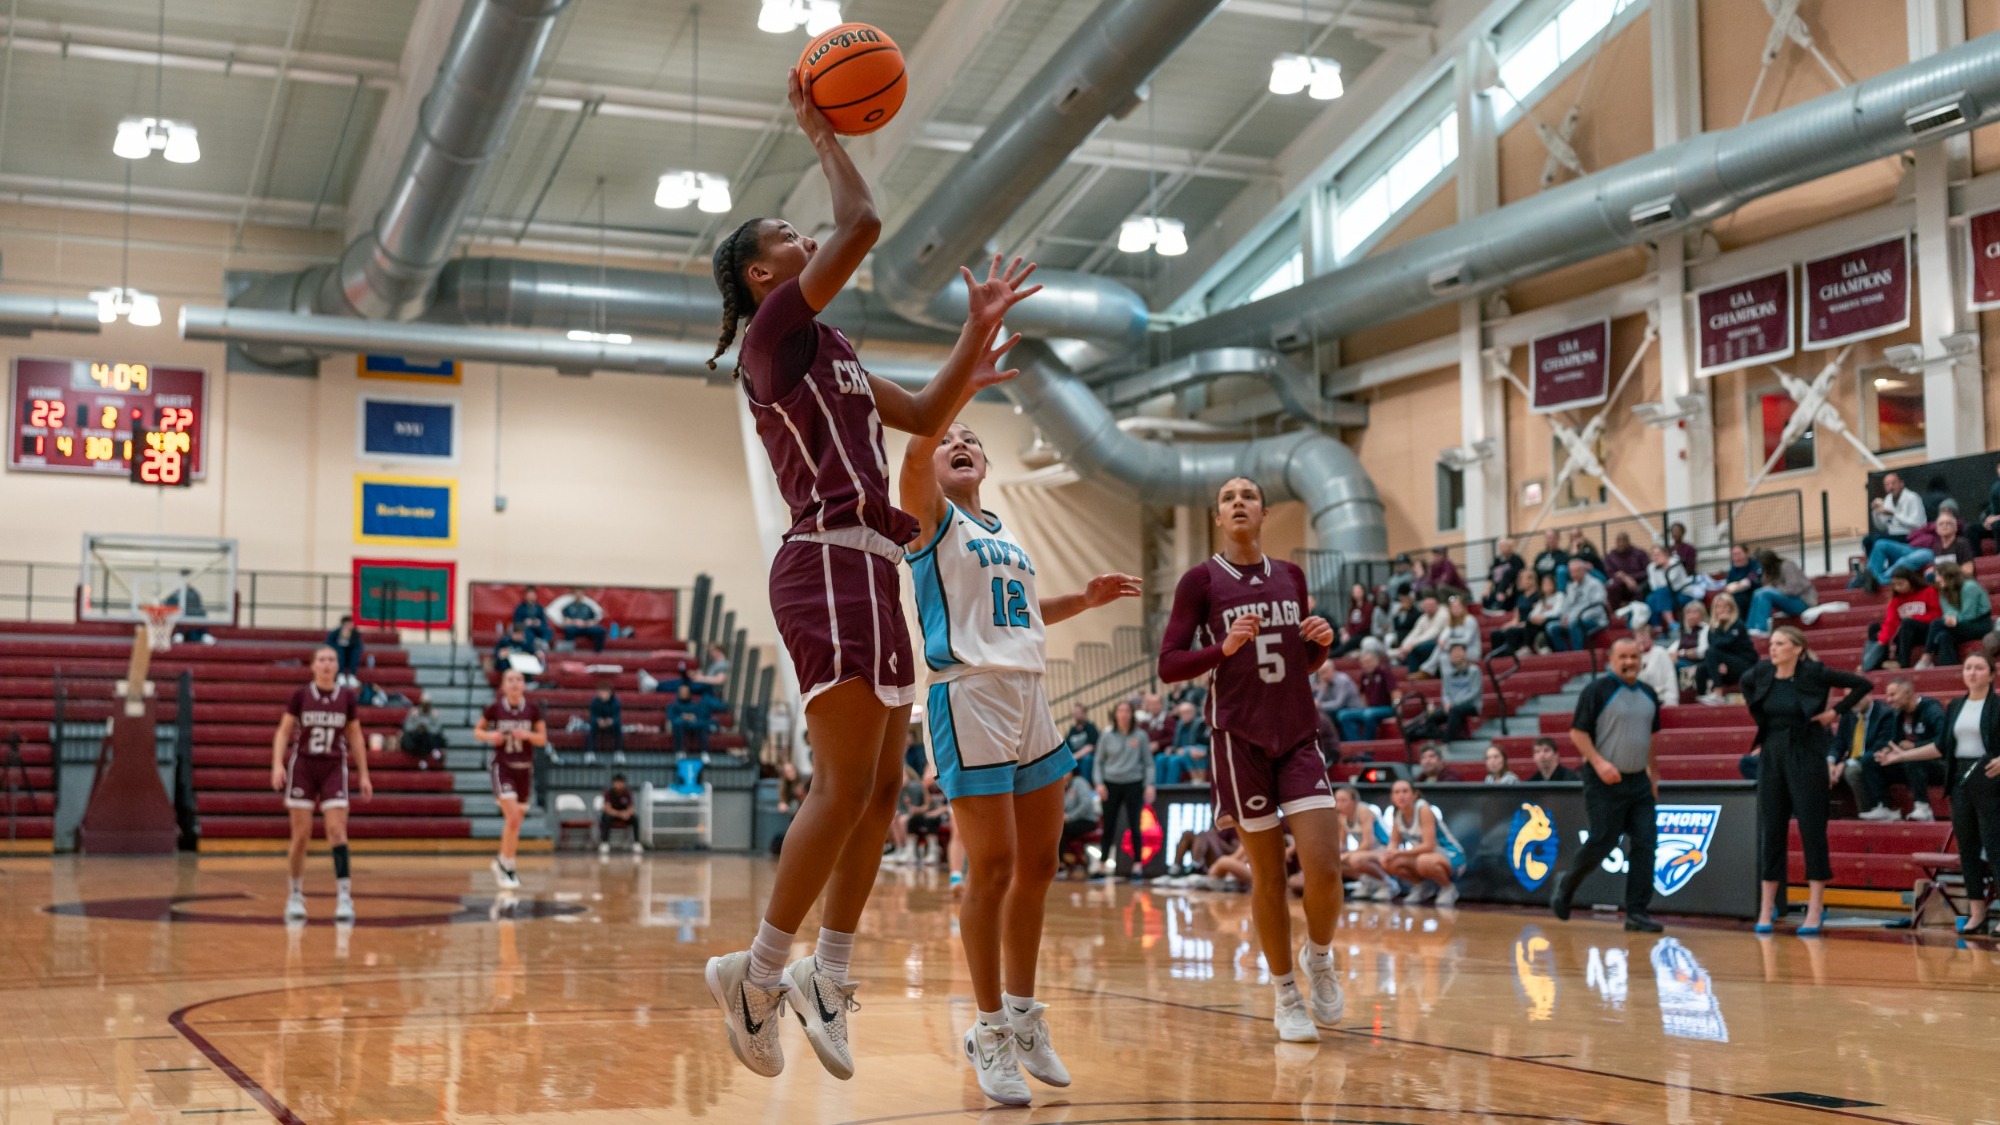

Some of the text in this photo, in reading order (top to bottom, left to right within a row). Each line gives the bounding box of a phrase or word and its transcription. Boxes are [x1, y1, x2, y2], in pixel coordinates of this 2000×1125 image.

[808, 29, 882, 66] Wilson
[1841, 258, 1868, 279] UAA
[1819, 268, 1893, 301] CHAMPIONS
[1729, 290, 1756, 309] UAA
[1708, 300, 1777, 331] CHAMPIONS
[1541, 348, 1598, 374] CHAMPIONS
[91, 363, 148, 391] 4:09
[31, 399, 66, 428] 22
[101, 406, 118, 429] 2
[56, 436, 73, 457] 4
[141, 448, 182, 483] 28
[991, 576, 1030, 629] 12
[1255, 633, 1286, 684] 5
[301, 710, 347, 728] CHICAGO
[309, 727, 336, 754] 21
[1655, 811, 1713, 827] EMORY
